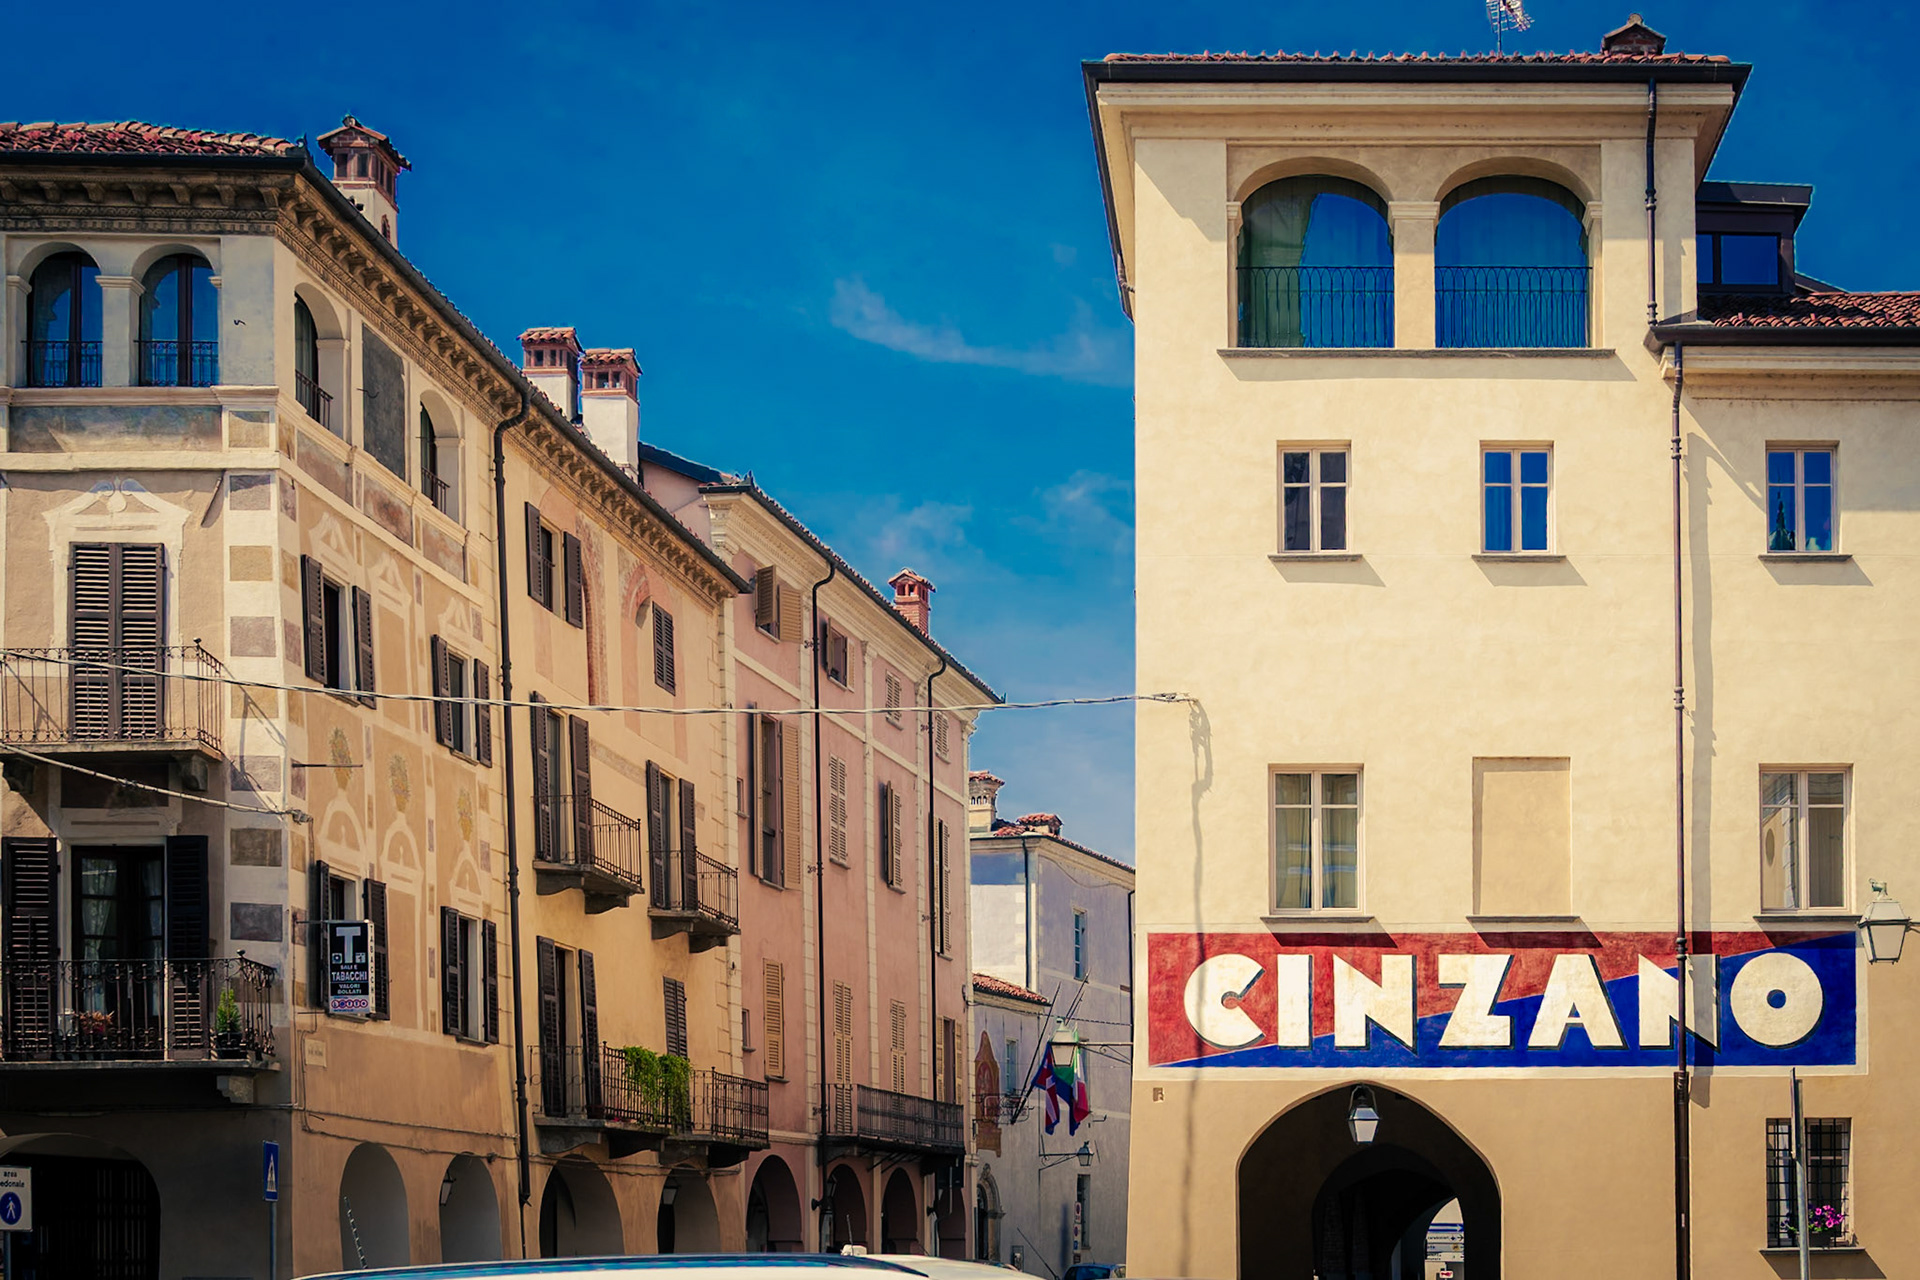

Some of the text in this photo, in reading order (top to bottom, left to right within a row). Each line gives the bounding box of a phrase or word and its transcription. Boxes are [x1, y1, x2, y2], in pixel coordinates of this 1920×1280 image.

[336, 926, 361, 964] T
[331, 971, 368, 981] TABACCHI
[1183, 952, 1824, 1052] CINZANO
